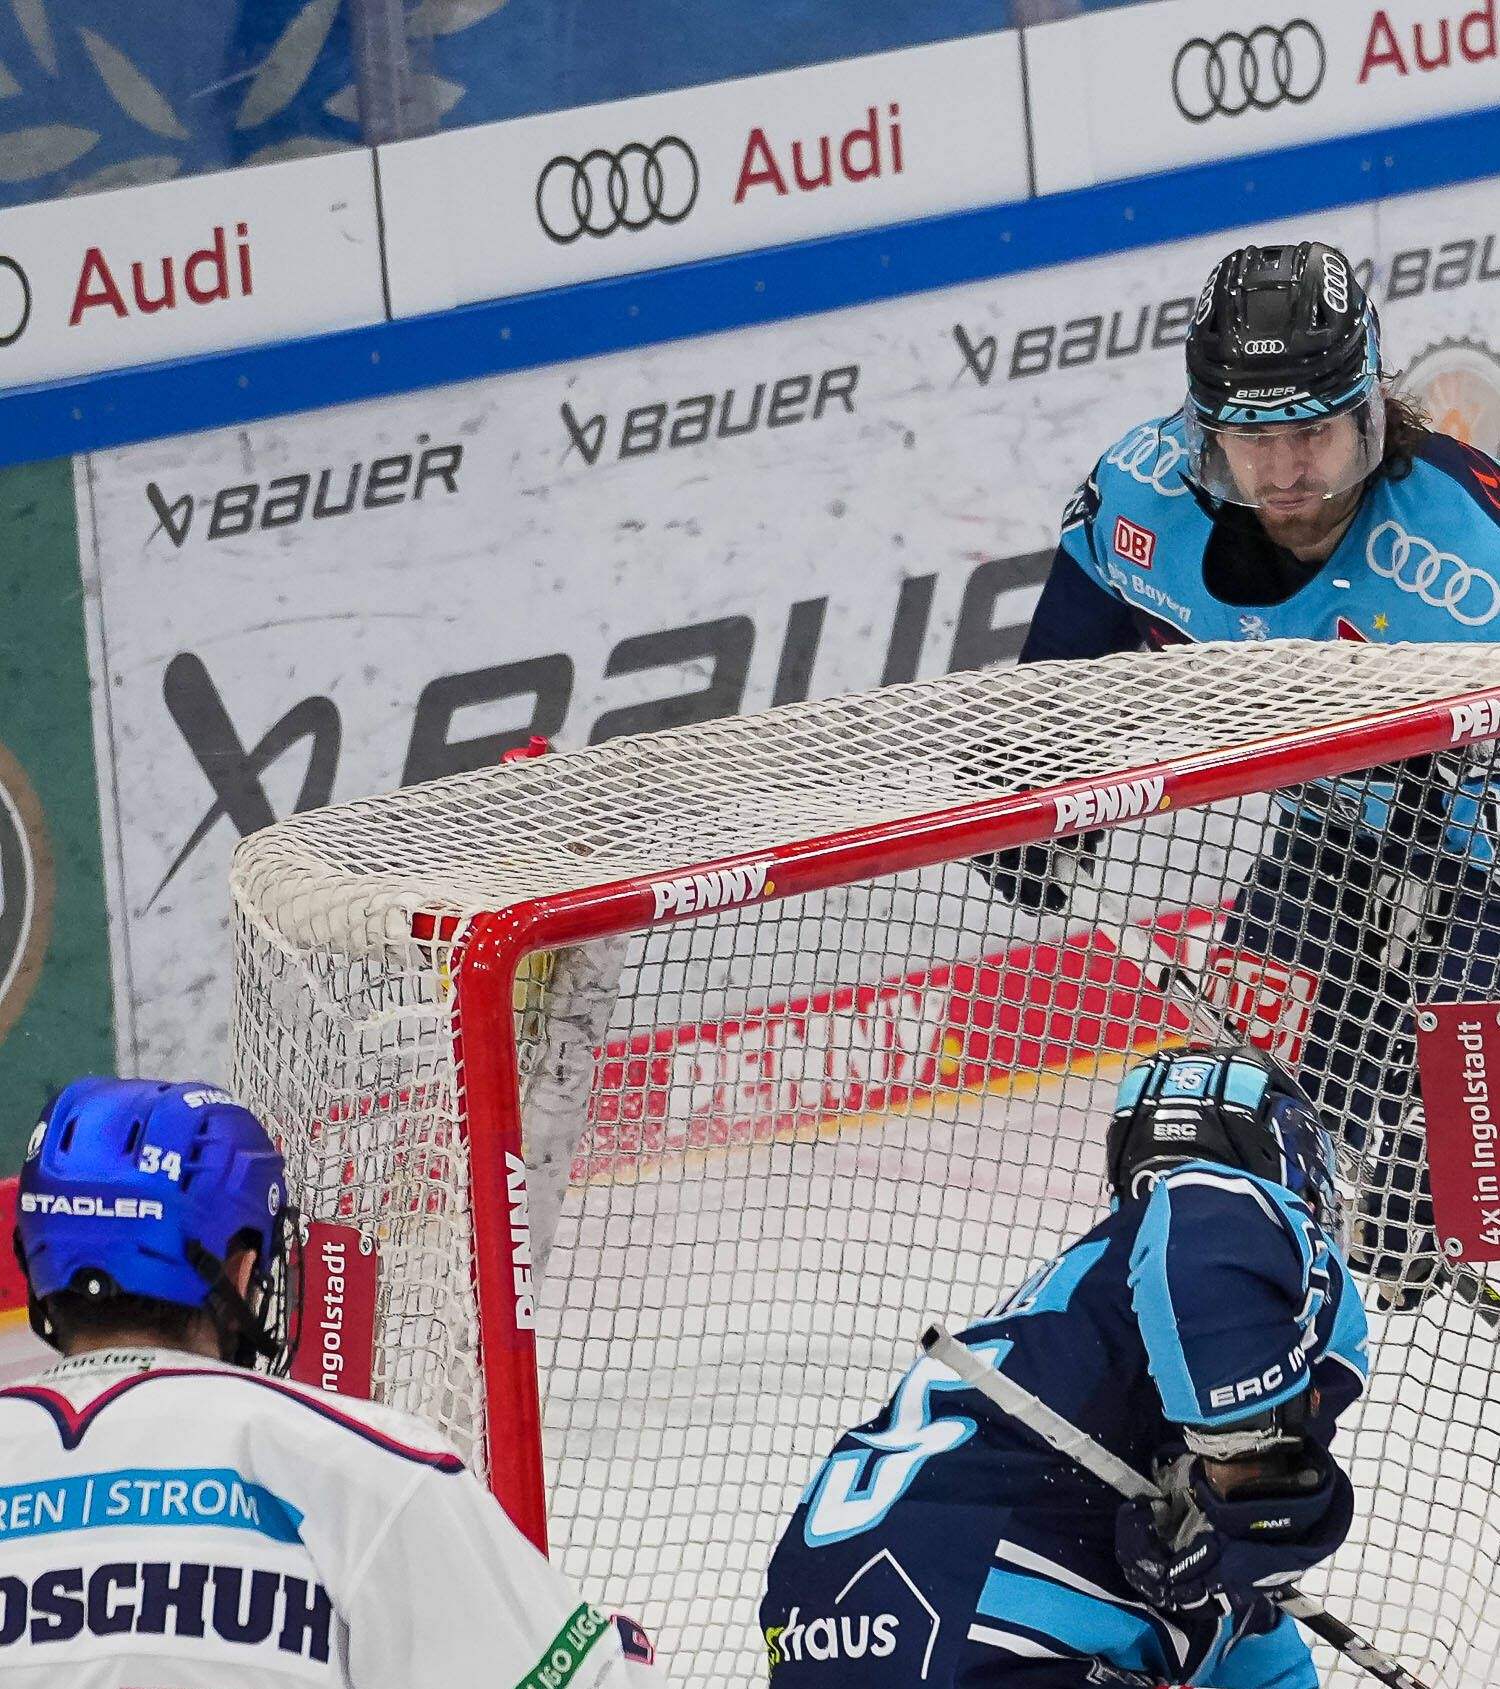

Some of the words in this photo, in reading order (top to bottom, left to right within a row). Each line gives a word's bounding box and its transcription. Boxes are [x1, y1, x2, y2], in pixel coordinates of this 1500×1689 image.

[734, 104, 906, 204] Audi
[68, 223, 256, 327] Audi
[1008, 296, 1196, 381] BAUE
[619, 365, 862, 460] BAUER
[1235, 385, 1297, 399] BAUER
[206, 444, 466, 543] BAUER
[1117, 521, 1150, 562] DB
[1456, 1020, 1499, 1168] Ingolstadt
[138, 1143, 182, 1182] 34
[1152, 1122, 1198, 1137] ERC
[20, 1192, 164, 1221] STADLER
[1472, 1175, 1500, 1203] in
[503, 1150, 539, 1332] PENNY
[321, 1240, 348, 1393] ngolstadt
[1210, 1365, 1284, 1409] ERC
[105, 1475, 261, 1526] STROM
